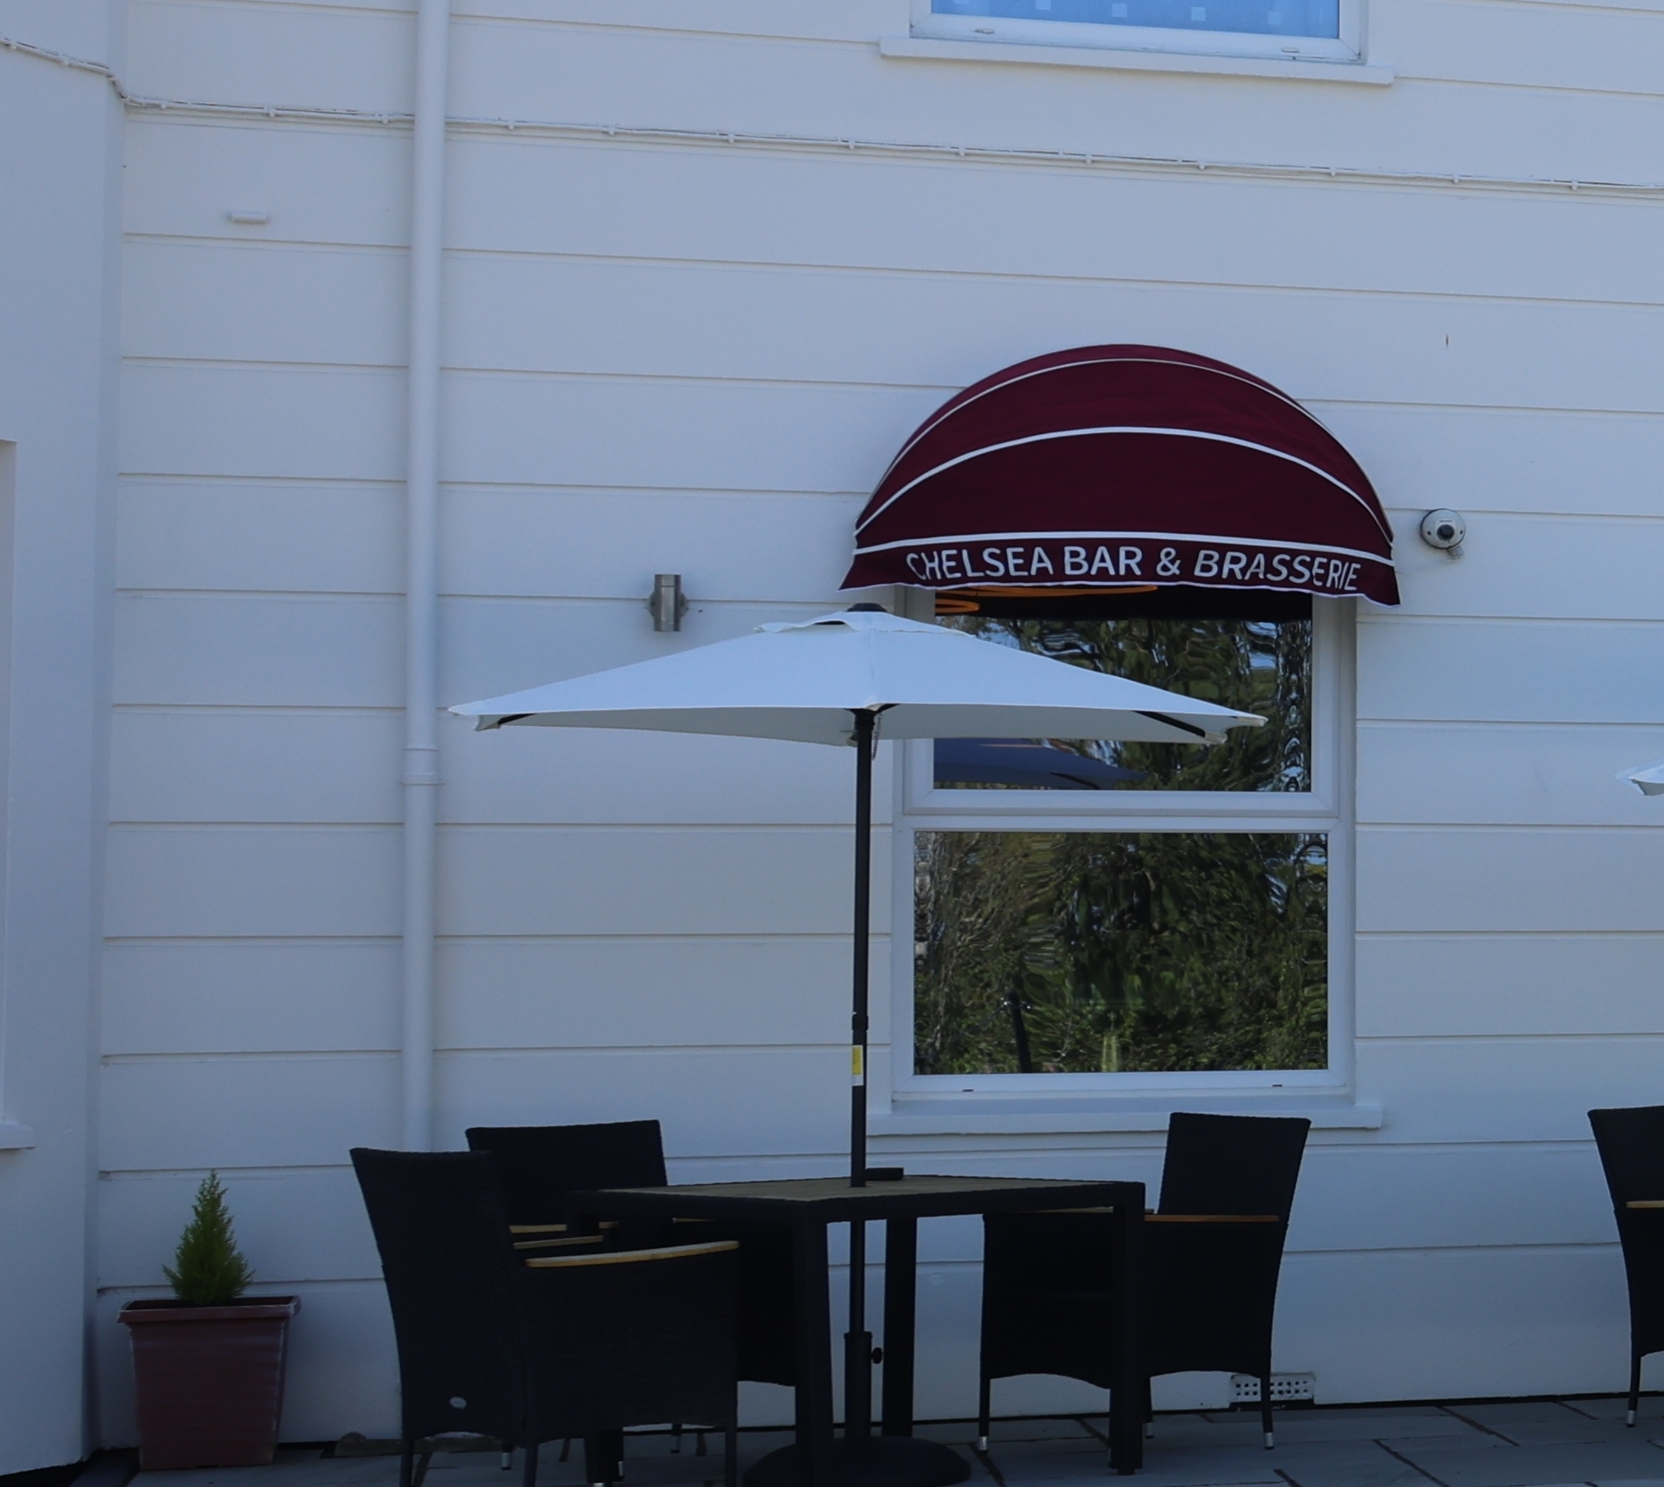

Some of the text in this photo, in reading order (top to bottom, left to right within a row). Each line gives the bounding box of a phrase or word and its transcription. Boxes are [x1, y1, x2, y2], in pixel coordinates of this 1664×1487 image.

[906, 546, 1362, 591] CHELSEA BAR & BRASSERIE
